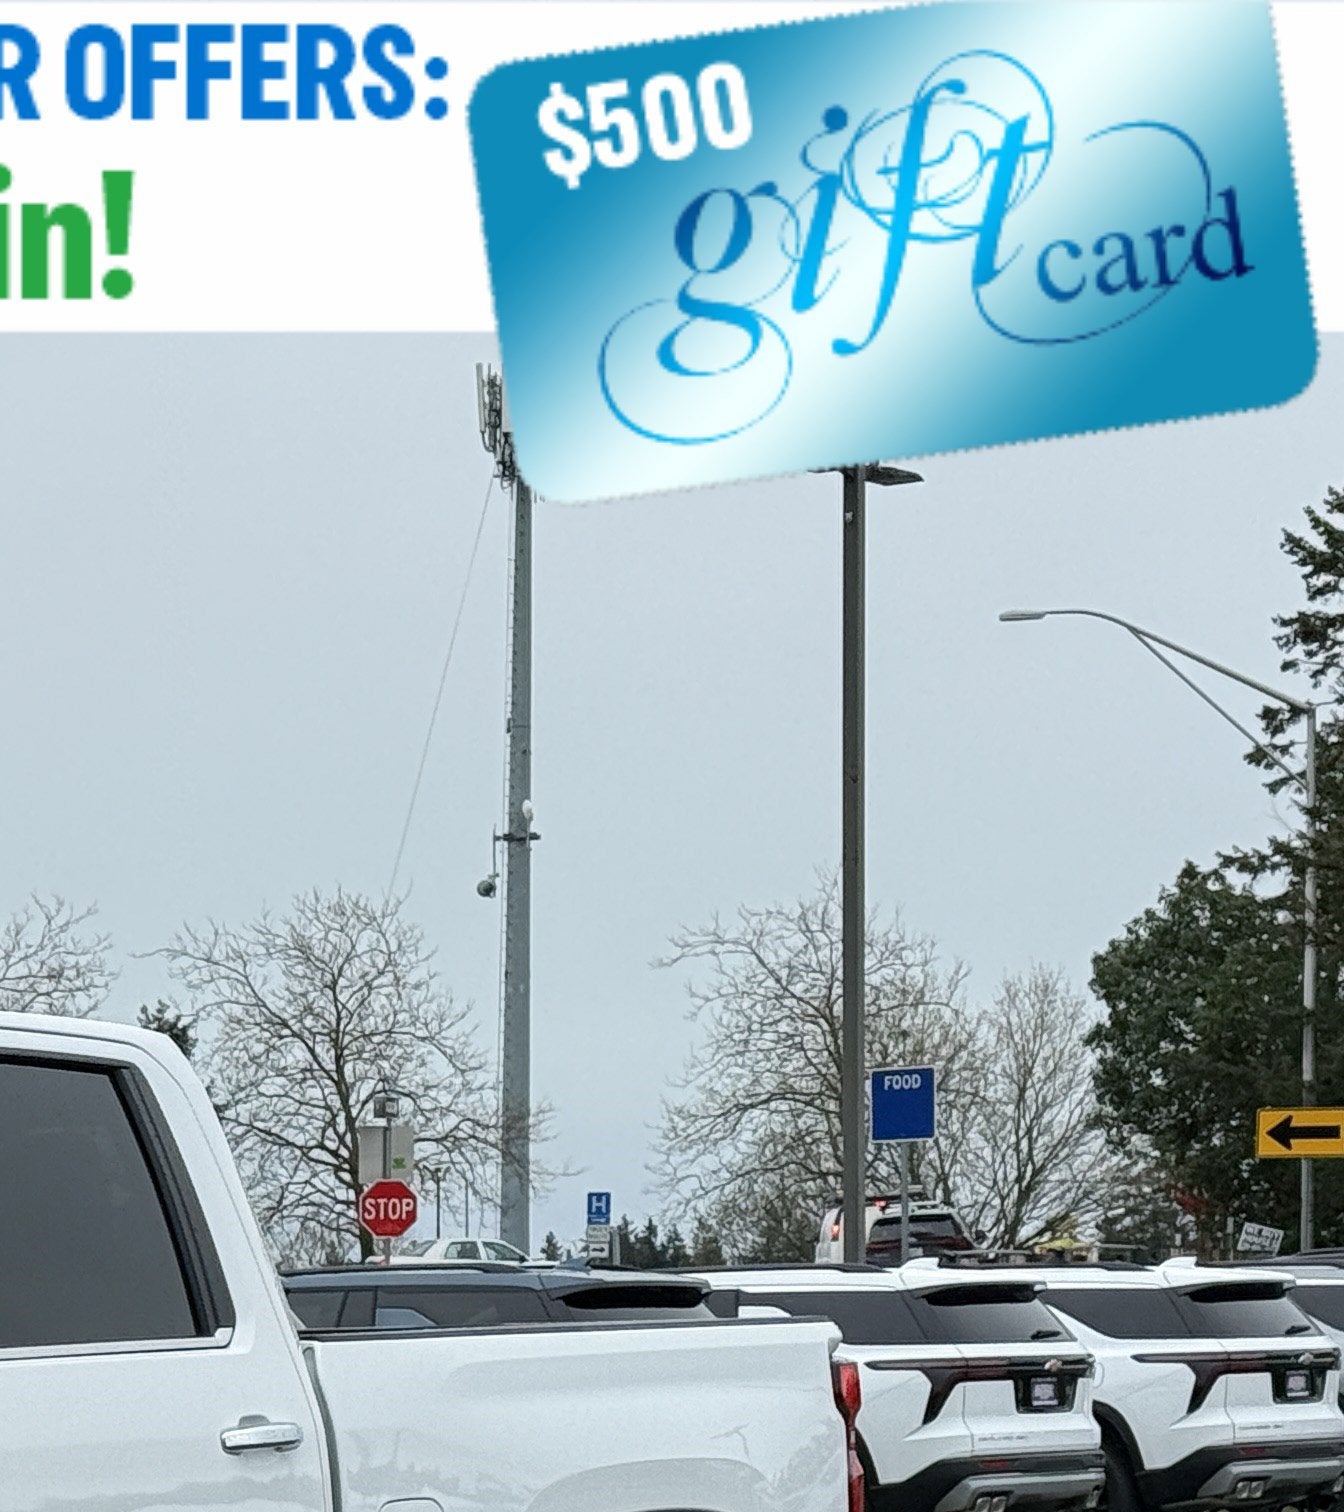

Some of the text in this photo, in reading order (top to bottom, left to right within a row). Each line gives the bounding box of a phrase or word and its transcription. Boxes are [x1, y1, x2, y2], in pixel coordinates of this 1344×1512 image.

[884, 1074, 922, 1091] FOOD
[364, 1198, 413, 1220] STOP
[592, 1195, 607, 1213] H
